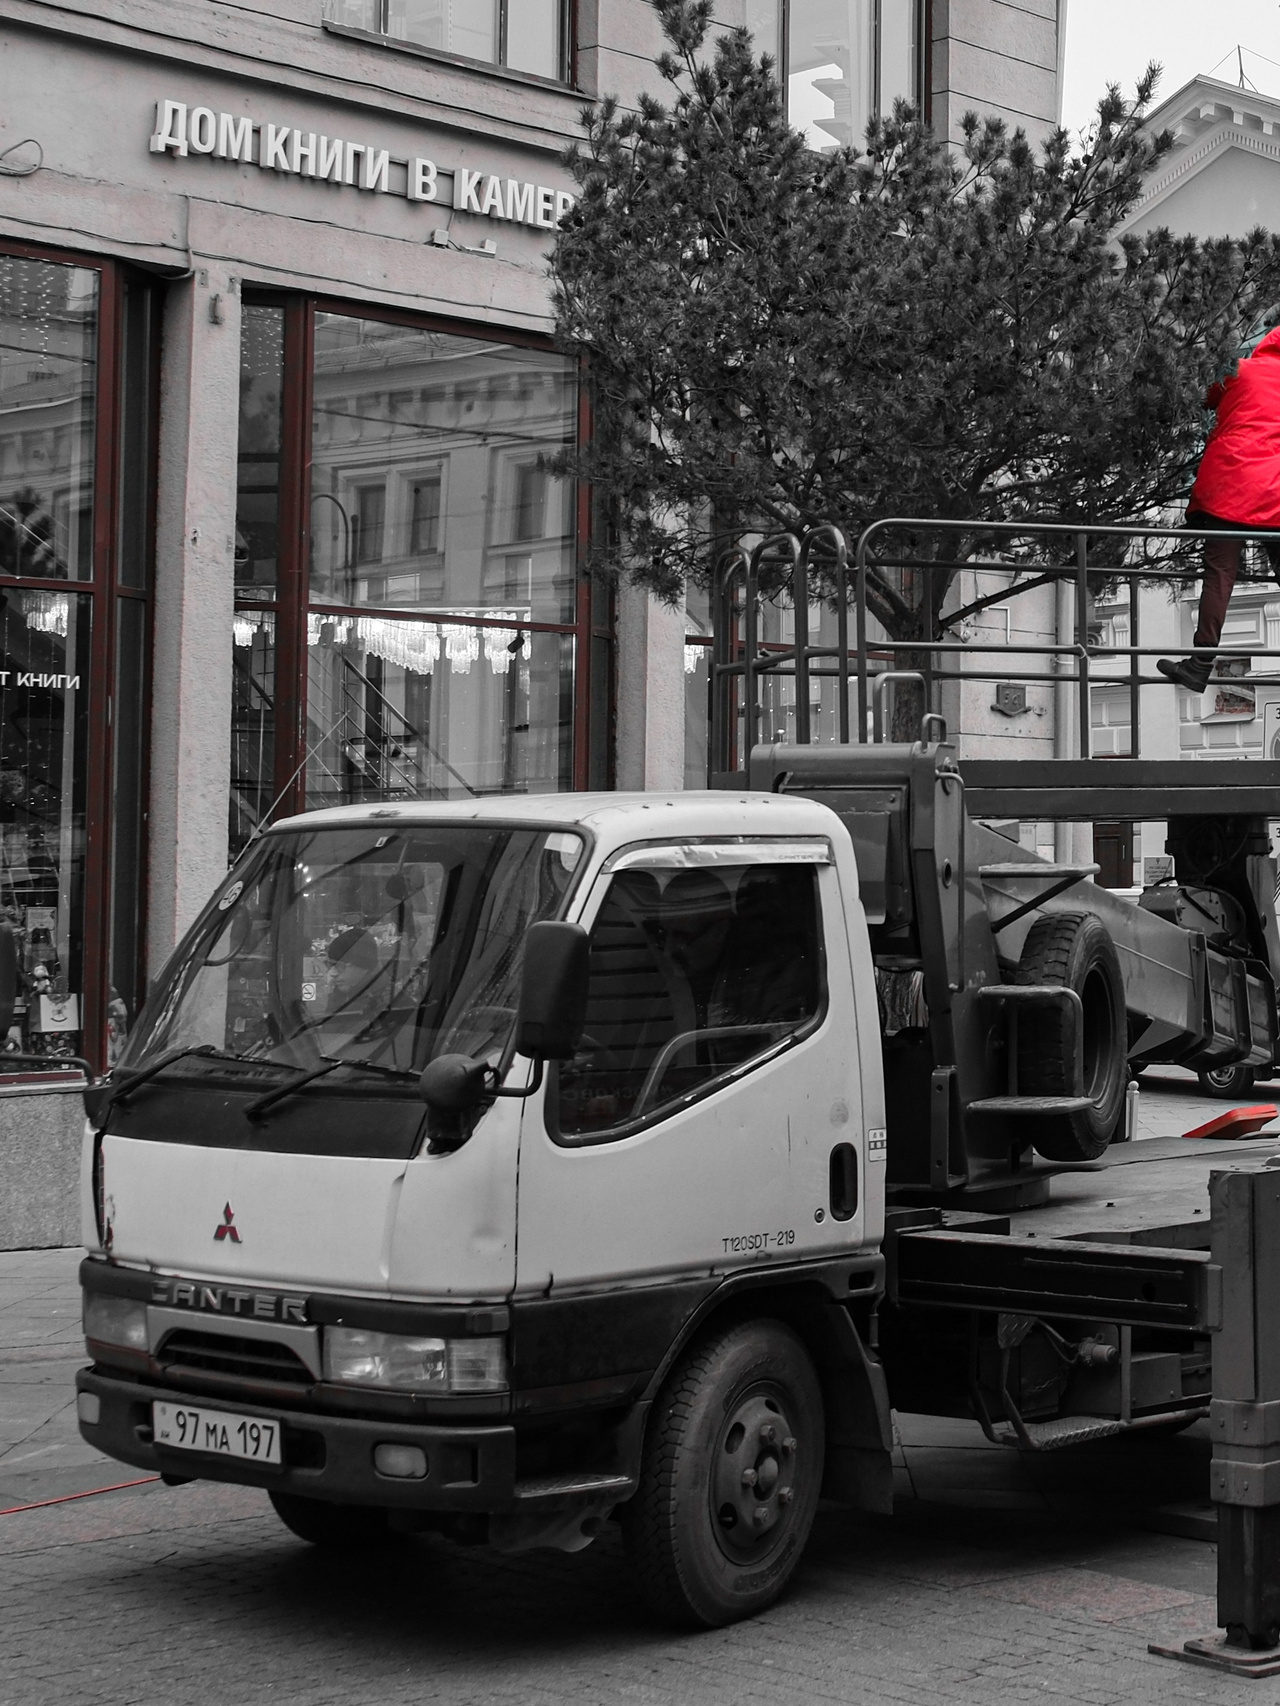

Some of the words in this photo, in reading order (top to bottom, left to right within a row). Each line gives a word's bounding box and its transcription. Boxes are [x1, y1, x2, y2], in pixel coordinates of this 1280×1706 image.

[150, 99, 253, 163] ДОМ
[260, 123, 389, 194] КНИГИ
[407, 157, 438, 203] В
[17, 671, 81, 690] КНИГИ
[721, 1229, 796, 1253] T120SDT-219
[151, 1280, 308, 1323] CANTER
[175, 1410, 200, 1445] 97
[237, 1421, 275, 1458] 197
